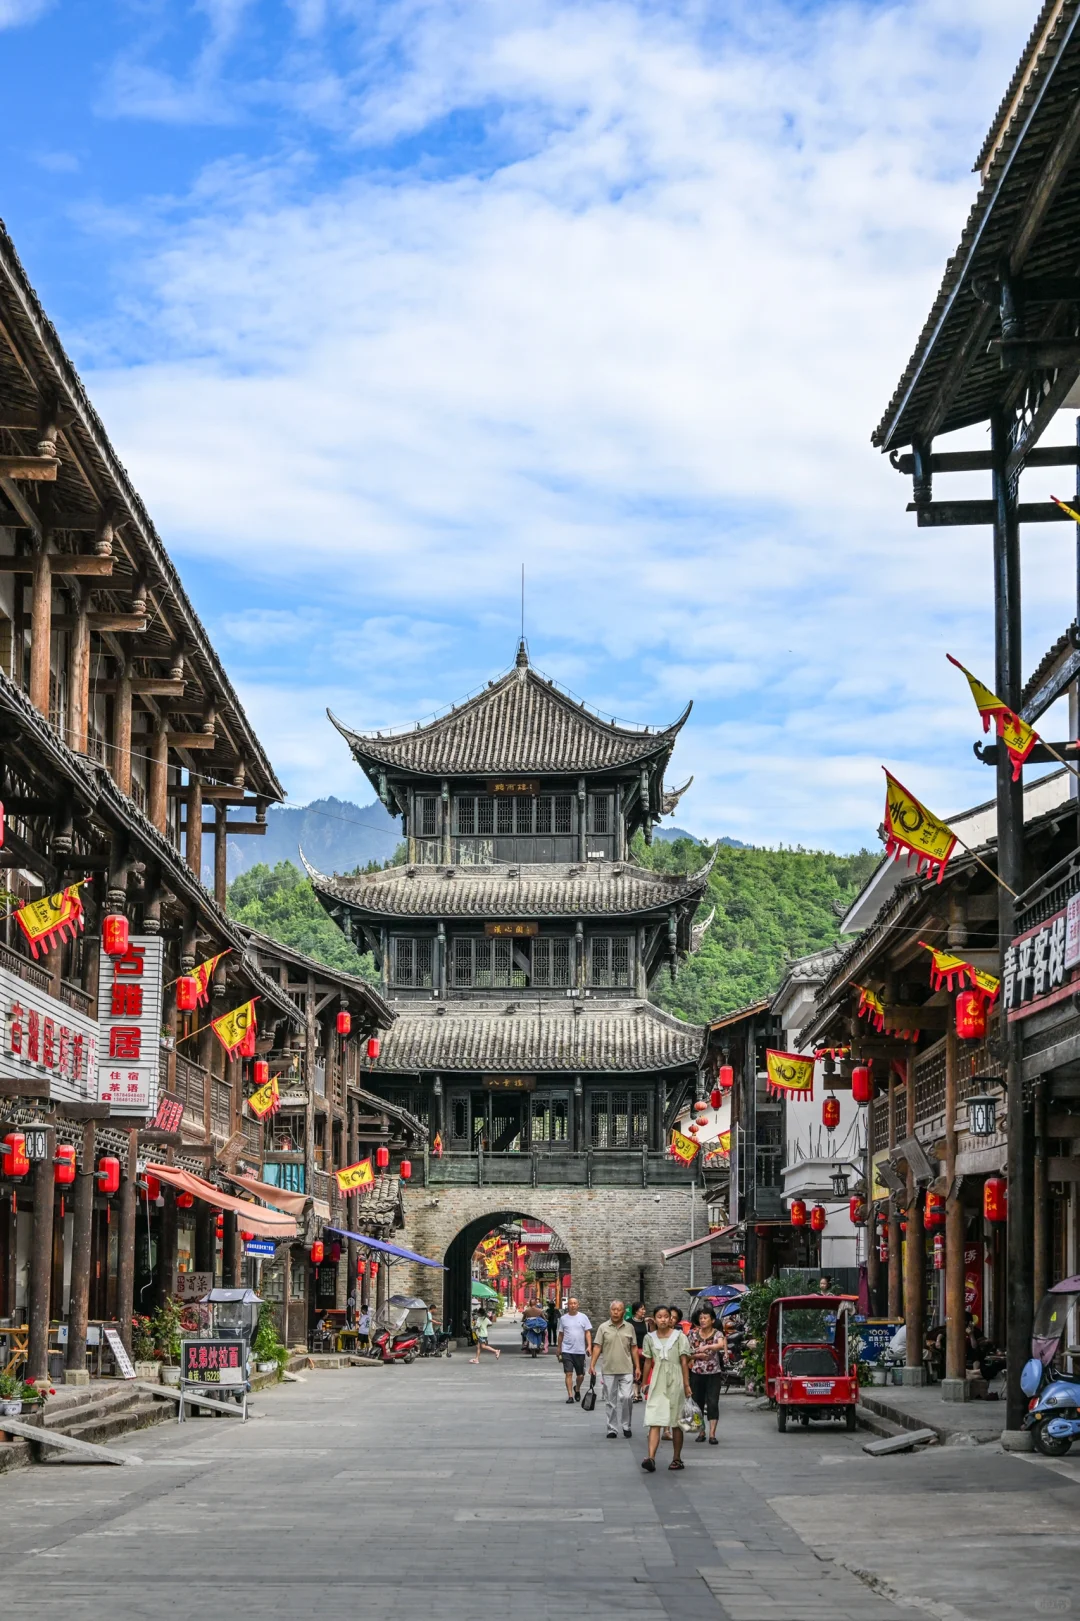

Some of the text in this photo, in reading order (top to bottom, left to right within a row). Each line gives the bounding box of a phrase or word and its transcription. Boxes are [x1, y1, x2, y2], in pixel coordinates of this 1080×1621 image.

[1003, 917, 1064, 1008] 青平客栈
[109, 943, 146, 1059] 古雅居
[109, 1071, 139, 1081] 住宿
[186, 1275, 208, 1292] 冒菜
[188, 1346, 239, 1369] 兄弟伙拉面
